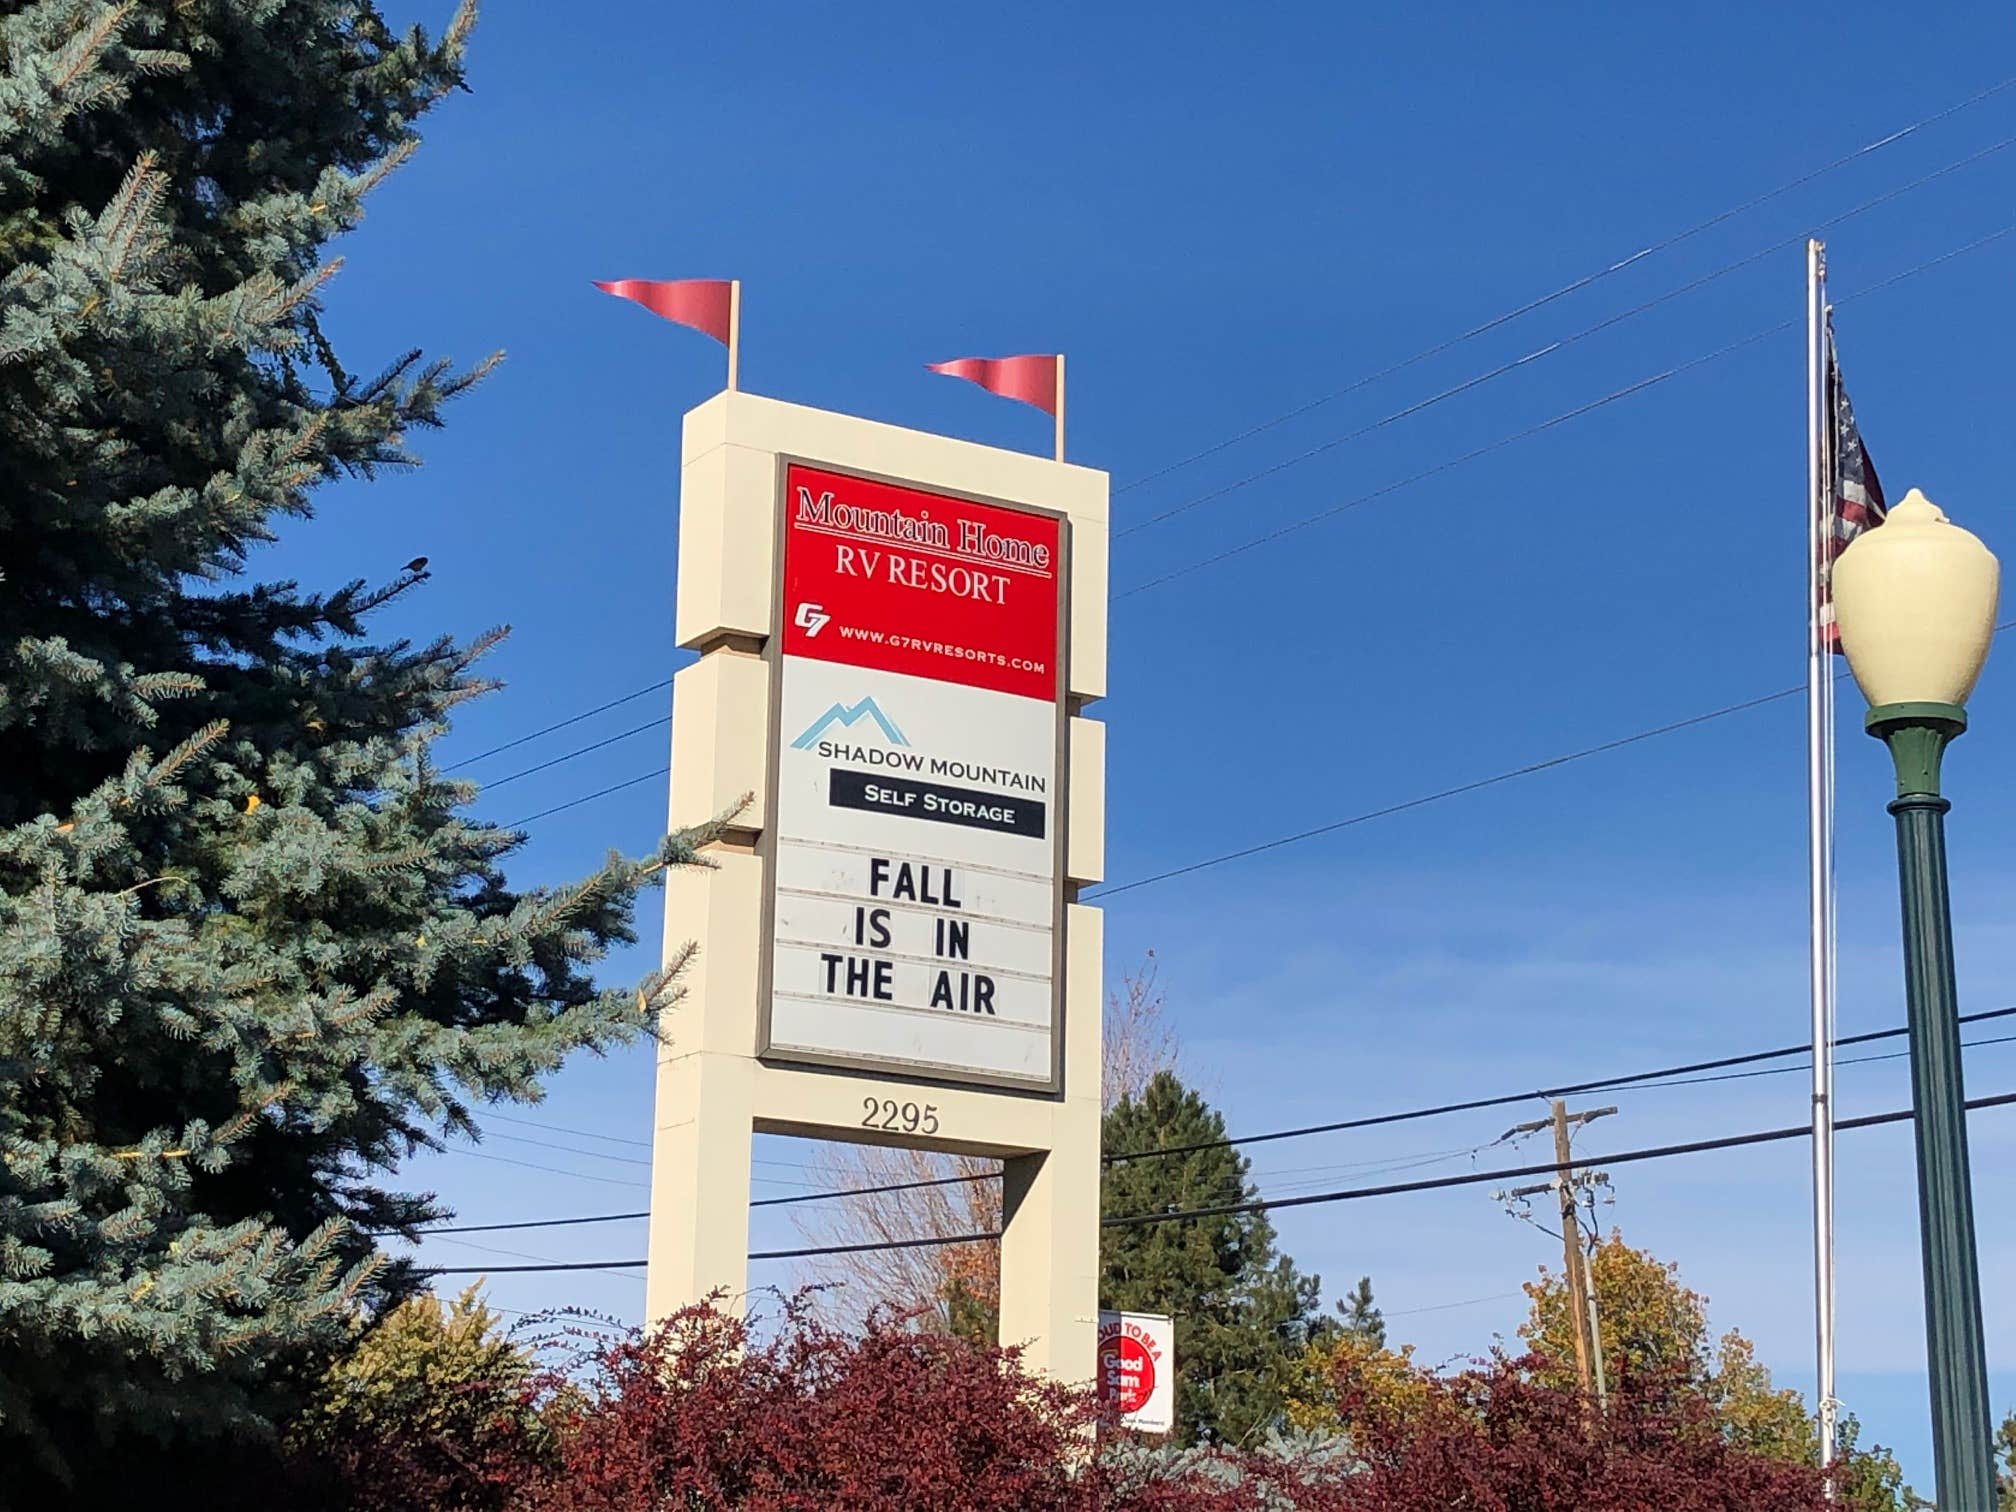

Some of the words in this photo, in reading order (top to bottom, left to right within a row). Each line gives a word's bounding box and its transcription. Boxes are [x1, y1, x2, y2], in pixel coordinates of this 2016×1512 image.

[796, 486, 950, 548] Mountain
[957, 518, 1050, 567] Home
[835, 544, 880, 579] RV
[888, 554, 1010, 606] RESORT
[839, 625, 1045, 674] WWW.G7RVRESORTS.COM
[818, 741, 924, 772] SHADOW
[930, 758, 1046, 793] MOUNTAIN
[870, 858, 961, 908] FALL
[856, 906, 891, 948] IS
[936, 918, 969, 960] IN
[821, 953, 893, 1000] THE
[930, 970, 996, 1016] AIR
[862, 1097, 939, 1134] 2295
[1125, 1323, 1141, 1338] TO
[1142, 1333, 1156, 1350] BE
